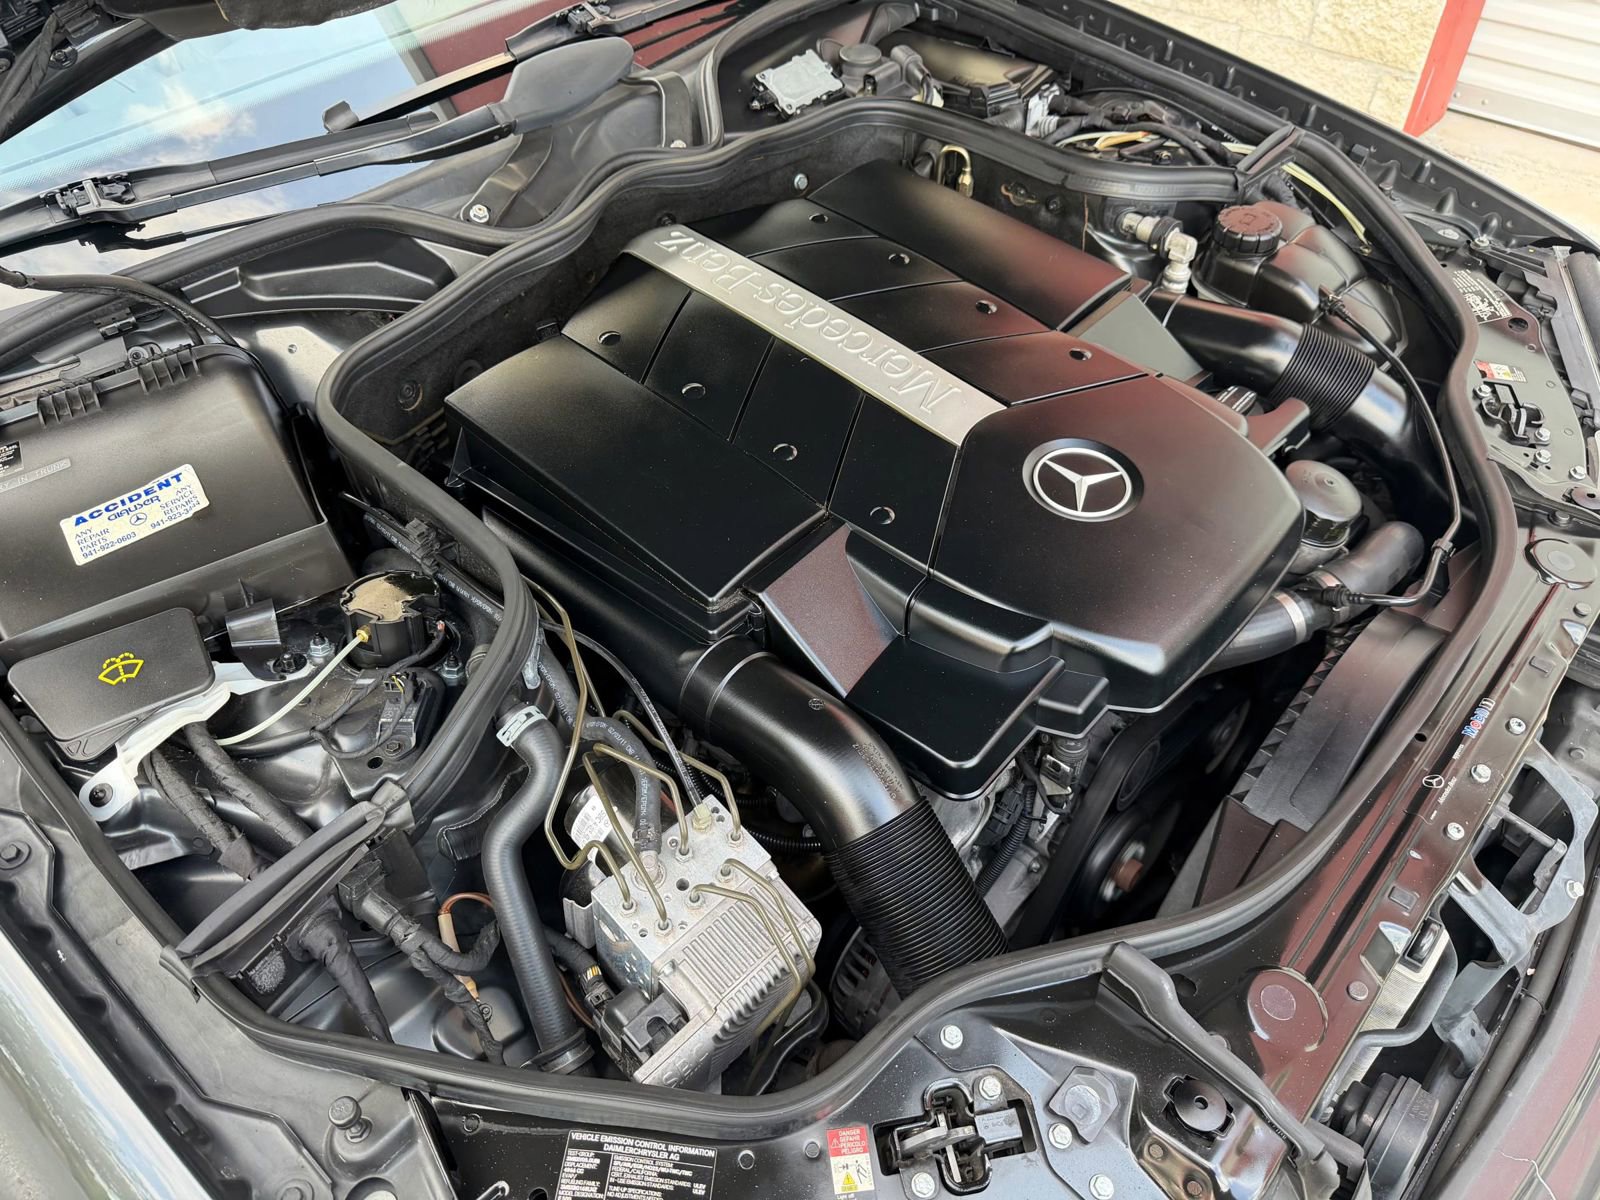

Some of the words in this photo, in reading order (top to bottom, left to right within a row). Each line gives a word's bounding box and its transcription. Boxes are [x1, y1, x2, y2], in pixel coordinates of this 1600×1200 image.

[654, 231, 962, 414] Mercedes-Benz
[74, 472, 183, 527] ACCIDENT
[160, 490, 194, 510] SERVICE
[163, 495, 198, 516] REPAIRS
[75, 527, 93, 540] ANY
[77, 528, 110, 546] REPAIR
[80, 537, 108, 552] PARTS
[82, 531, 137, 559] 941-922-0603
[1461, 707, 1490, 739] Mobil
[571, 1132, 600, 1142] VEHICLE
[600, 1135, 634, 1146] EMISSION
[634, 1140, 667, 1151] CONTROL
[667, 1144, 715, 1158] INFORMATION
[603, 1143, 669, 1159] DAIMLERCHRYSLER
[669, 1153, 680, 1161] AG
